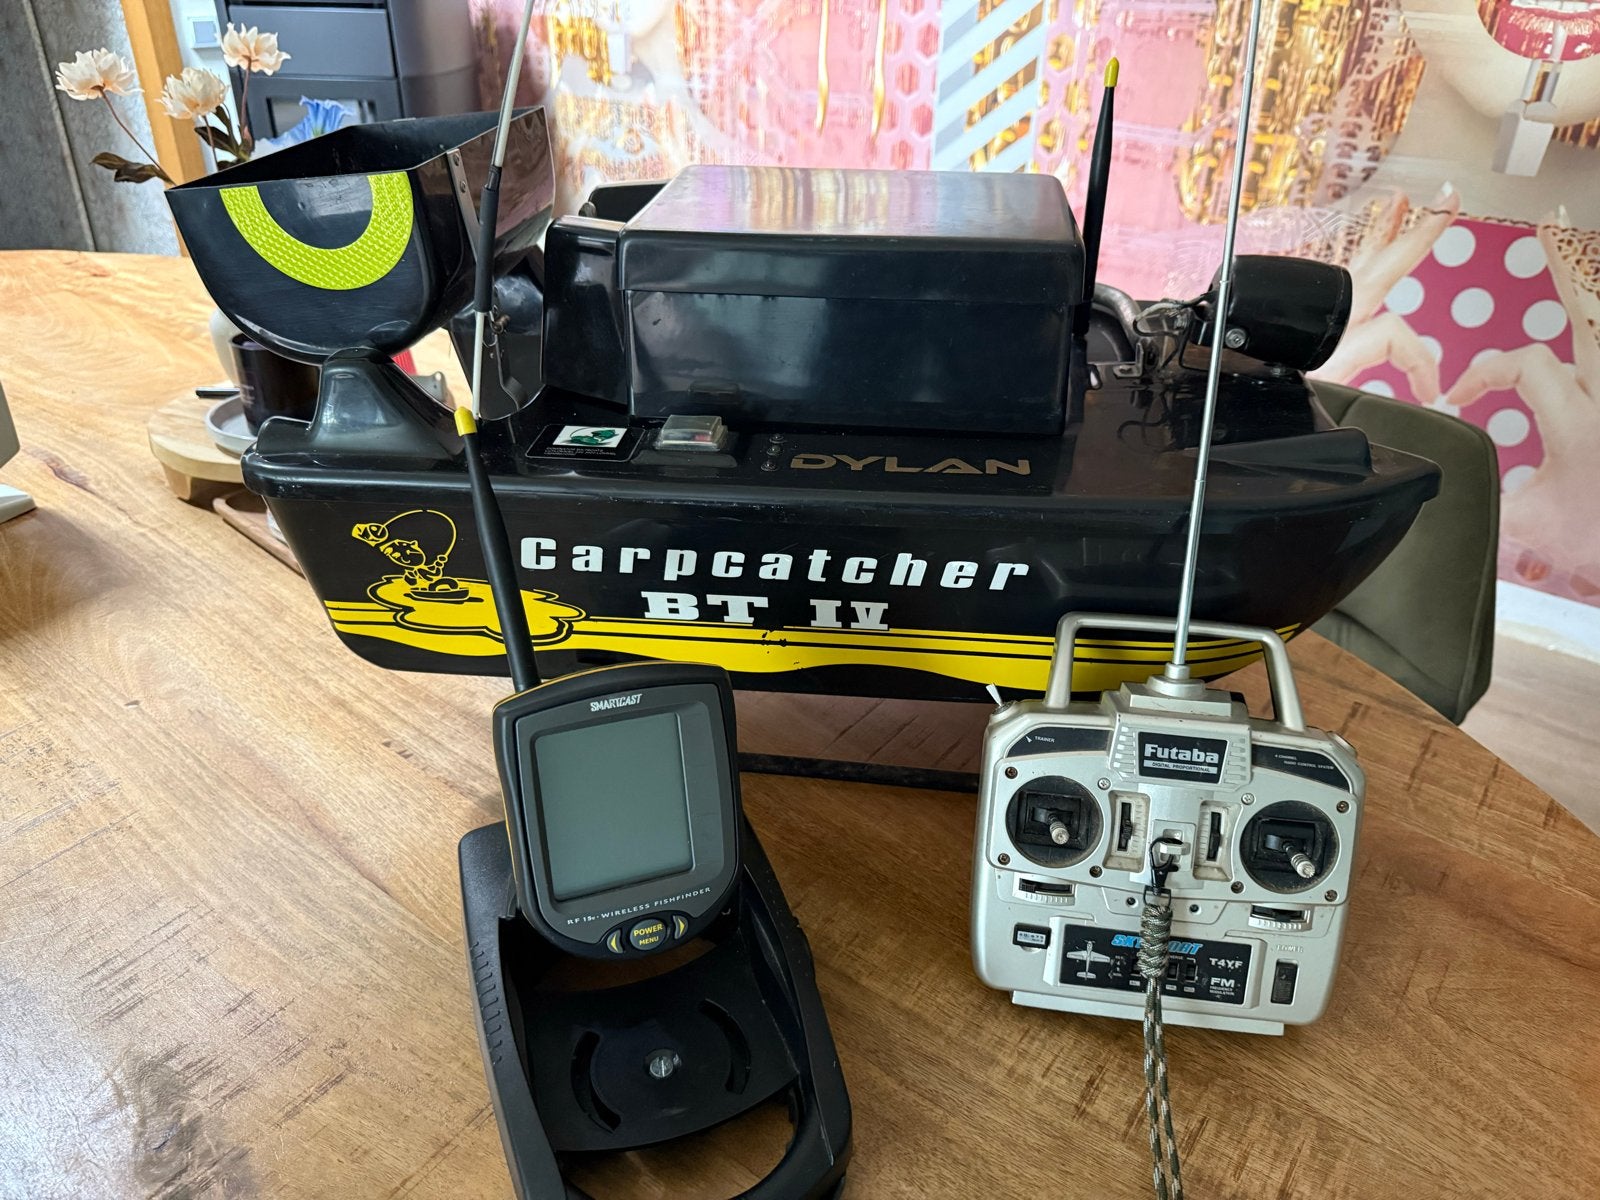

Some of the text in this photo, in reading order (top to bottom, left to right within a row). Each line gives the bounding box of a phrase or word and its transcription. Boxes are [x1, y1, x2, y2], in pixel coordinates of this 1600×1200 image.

[790, 453, 1031, 476] DYLAN
[520, 537, 1030, 591] Carpcatcher
[640, 591, 890, 631] BT IV
[590, 693, 642, 712] SMARTCAST
[1034, 735, 1055, 743] TRAINER
[1144, 743, 1220, 764] Futaba
[1172, 764, 1210, 773] PROPORTIONAL
[567, 917, 580, 925] RF
[600, 903, 650, 919] WIRELESS
[654, 886, 711, 907] FISHFINDER
[633, 923, 663, 937] POWER
[639, 935, 659, 946] MENU
[1209, 957, 1243, 970] T4YF
[1210, 977, 1235, 988] FM
